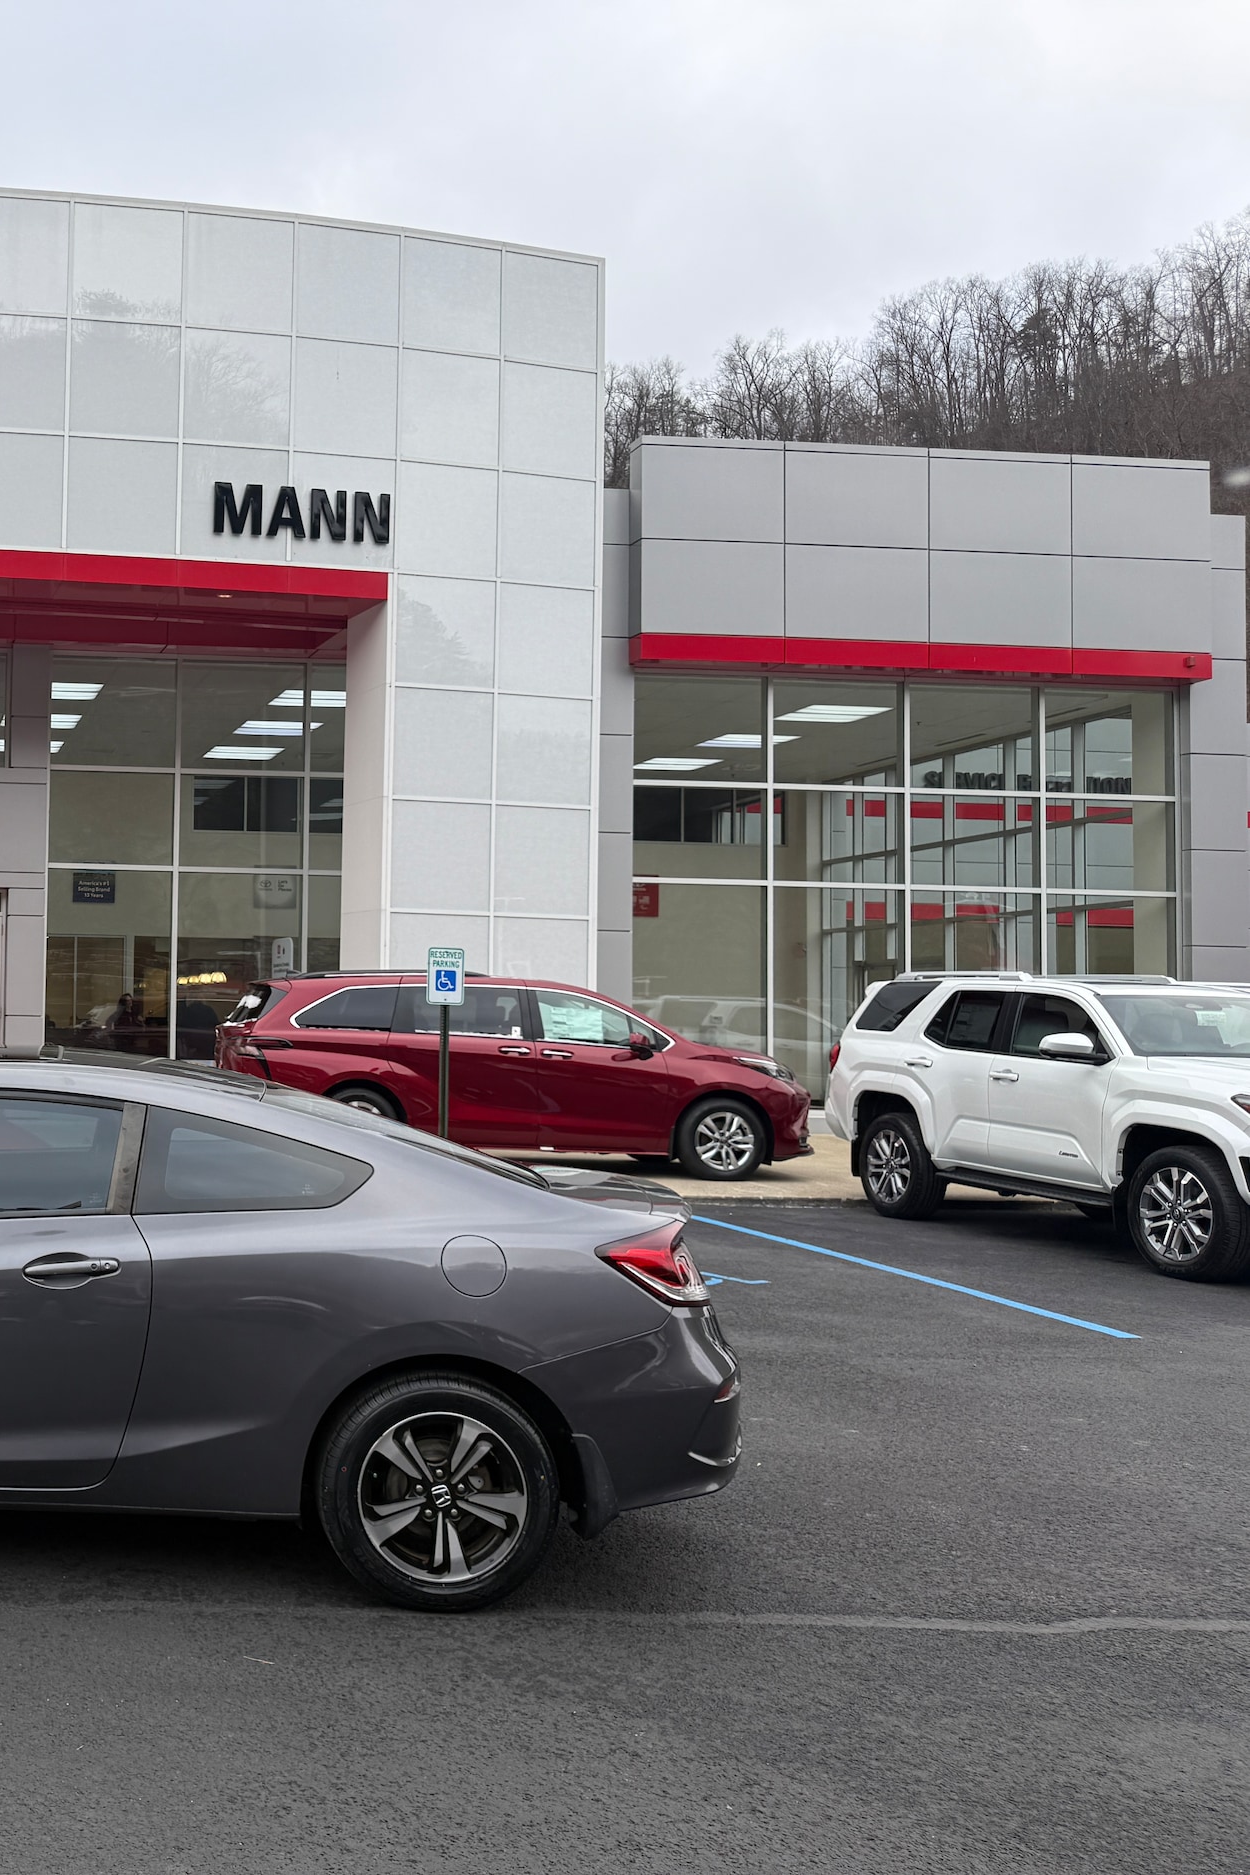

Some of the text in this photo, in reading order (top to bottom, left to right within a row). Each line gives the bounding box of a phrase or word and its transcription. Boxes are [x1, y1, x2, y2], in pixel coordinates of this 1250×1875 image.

[214, 481, 391, 544] MANN
[430, 950, 462, 960] RESERVED
[432, 960, 460, 968] PARKING
